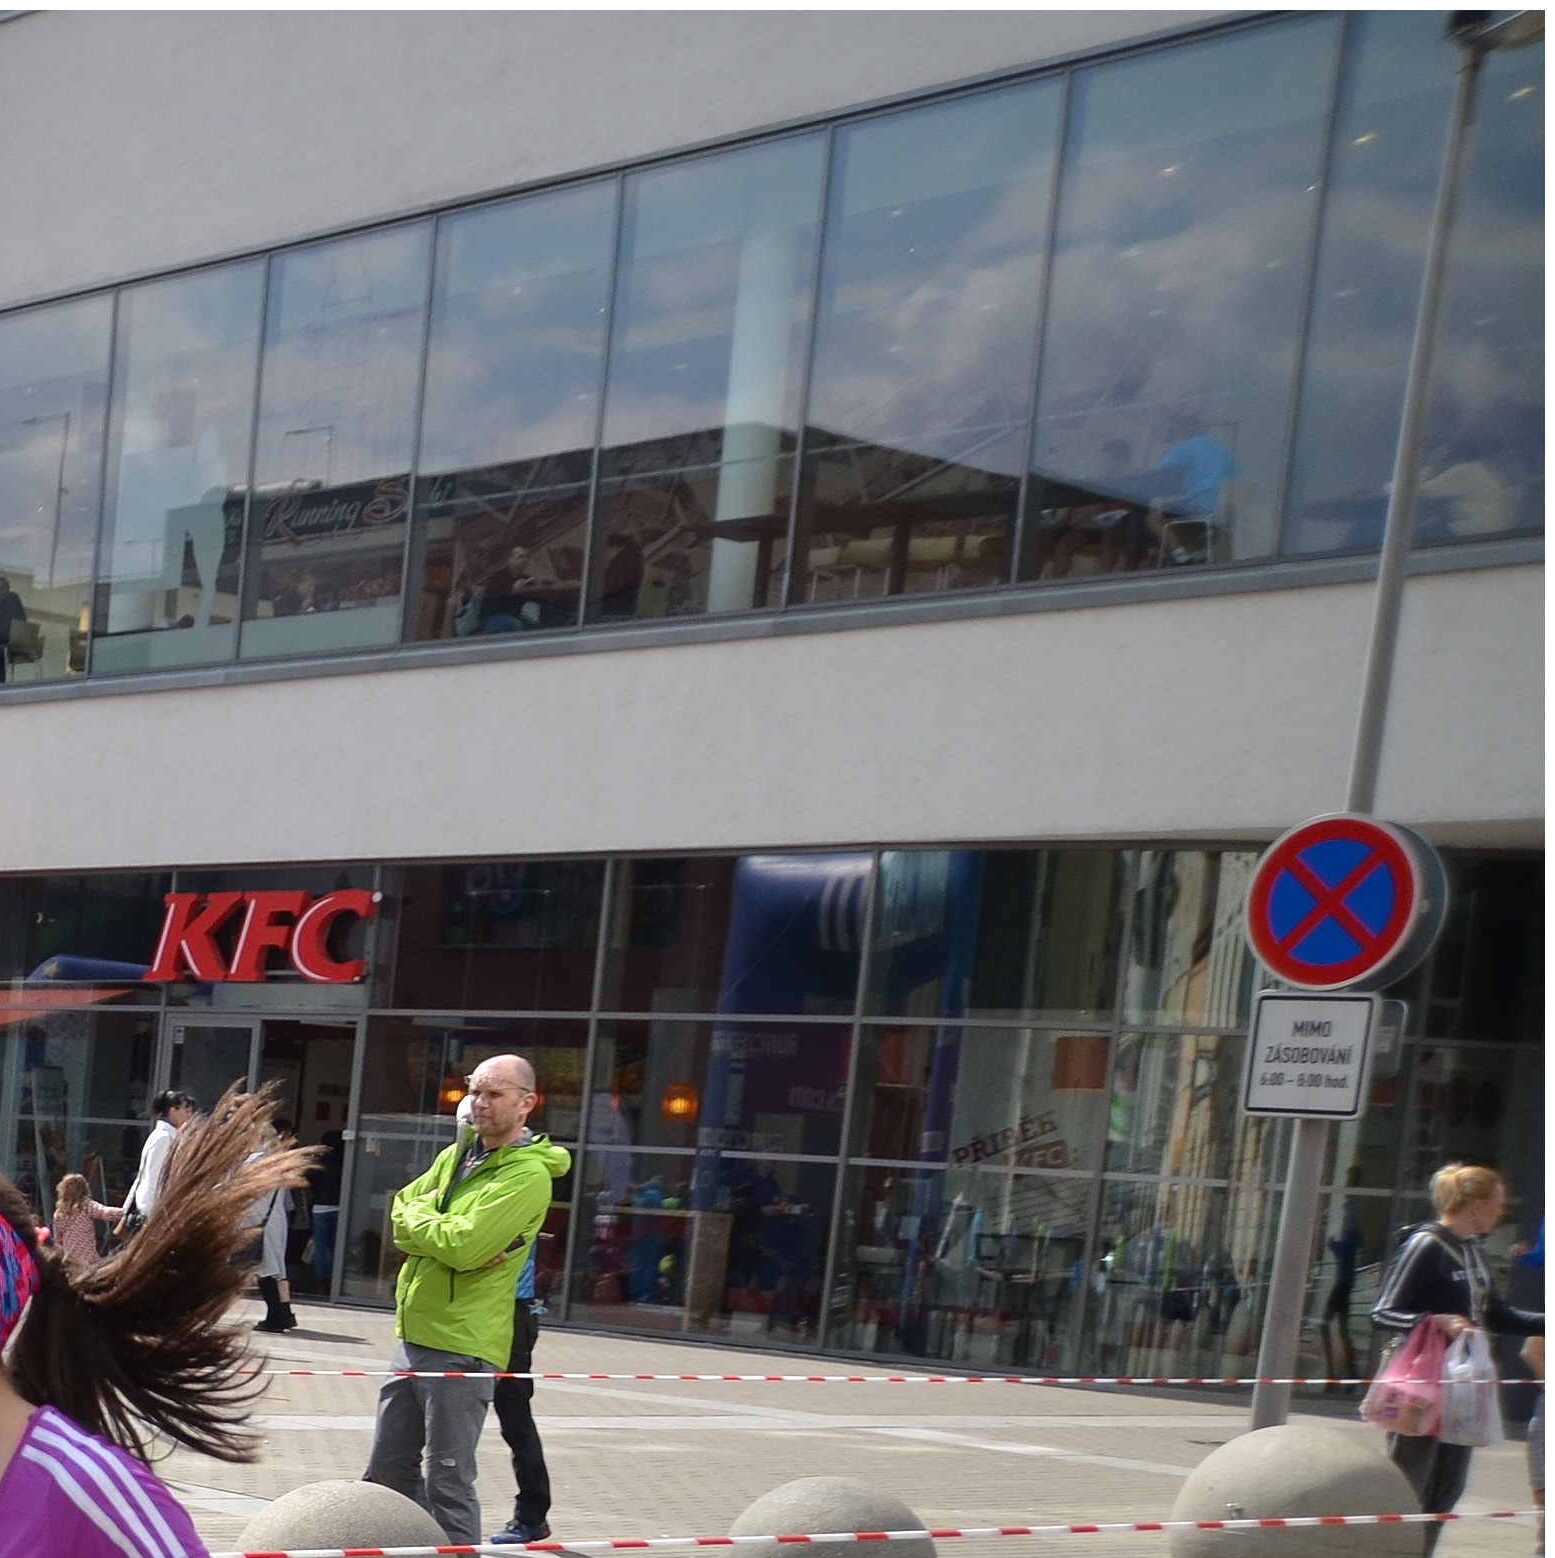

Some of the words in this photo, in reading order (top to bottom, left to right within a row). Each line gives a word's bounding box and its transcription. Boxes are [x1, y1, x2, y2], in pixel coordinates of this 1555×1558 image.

[143, 888, 379, 984] KFC
[1291, 1020, 1332, 1037] MIMO
[1264, 1043, 1354, 1065] ZÁSOBOVÁNÍ
